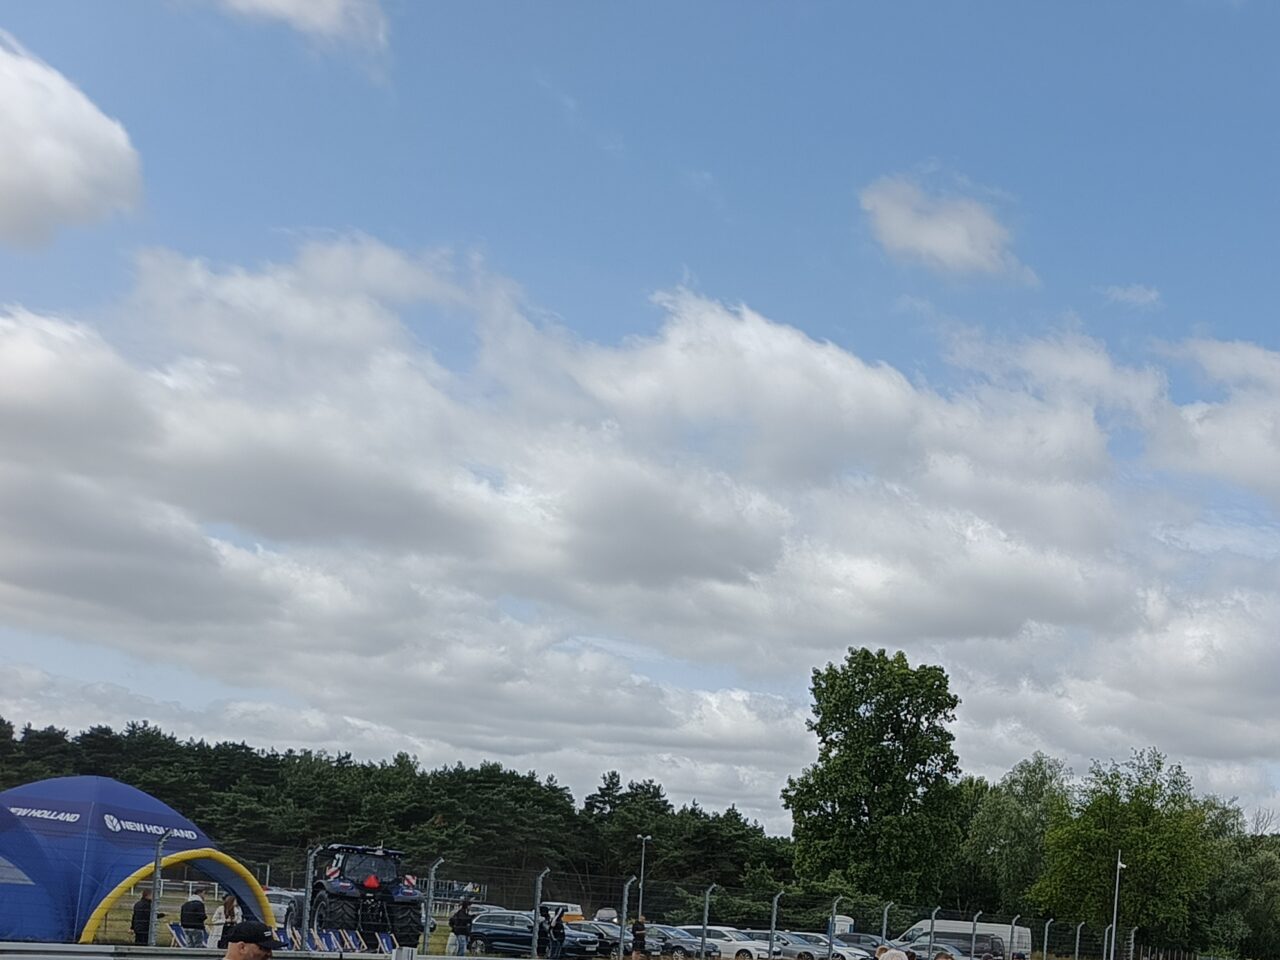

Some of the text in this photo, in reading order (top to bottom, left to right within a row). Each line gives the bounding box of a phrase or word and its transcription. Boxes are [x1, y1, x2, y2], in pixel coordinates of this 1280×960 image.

[28, 809, 80, 822] HOLLAND
[120, 820, 198, 840] NEW HOLAND
